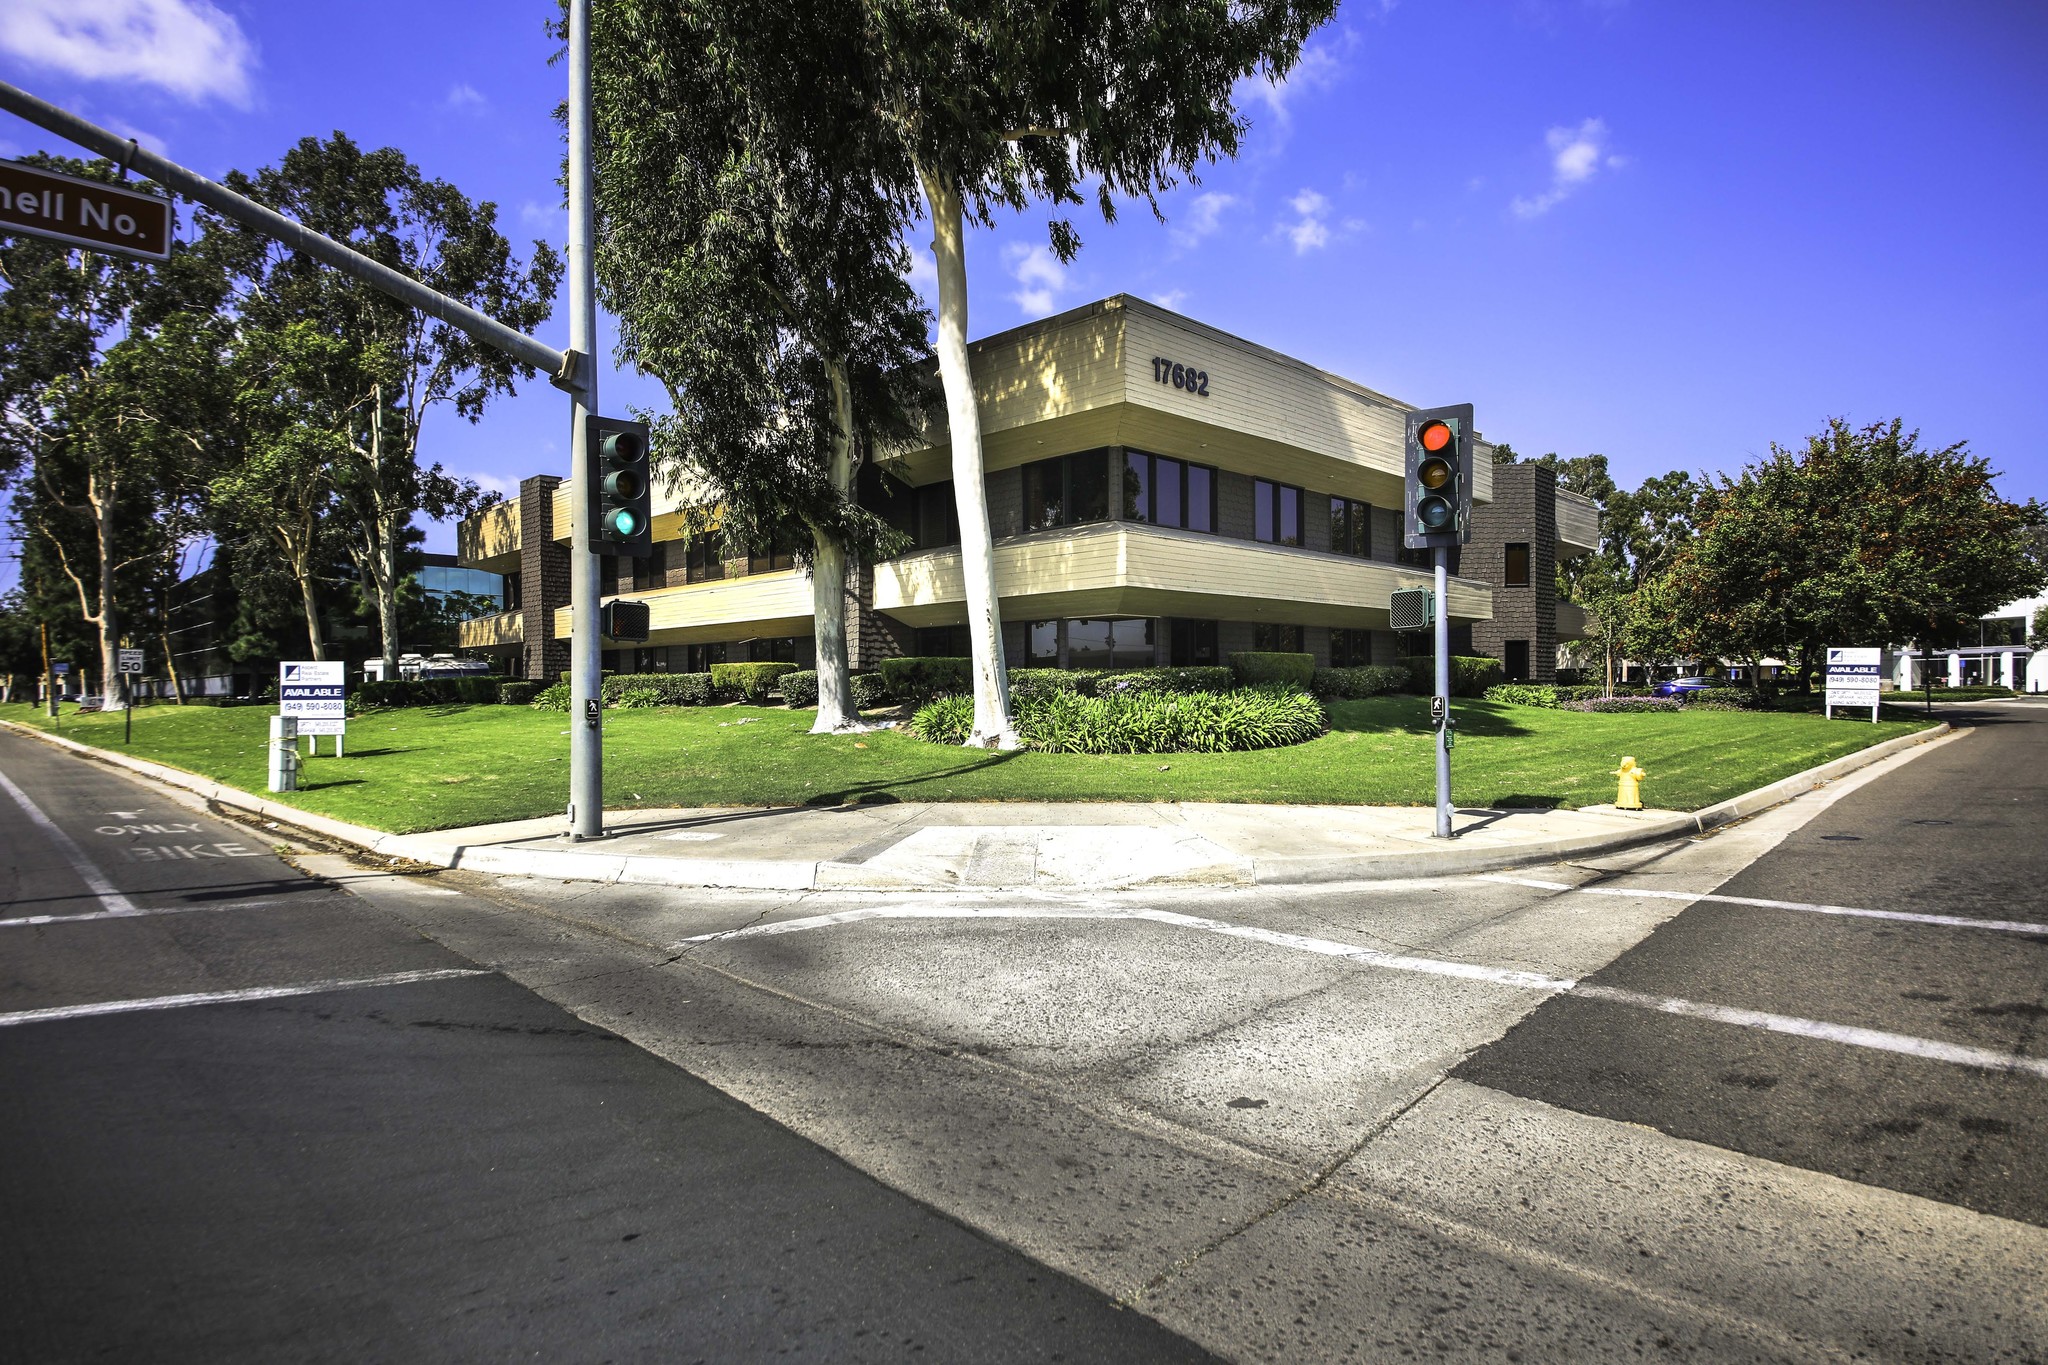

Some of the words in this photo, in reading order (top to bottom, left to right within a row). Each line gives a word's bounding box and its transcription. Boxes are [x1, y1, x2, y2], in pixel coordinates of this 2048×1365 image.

[80, 197, 146, 239] No.
[1152, 356, 1209, 397] 17682
[120, 661, 141, 671] 50
[1829, 666, 1878, 674] AVAILABLE
[283, 688, 342, 697] AVAILABLE
[284, 702, 304, 712] (949)
[95, 823, 203, 835] ONLY
[124, 843, 262, 862] BIKE
